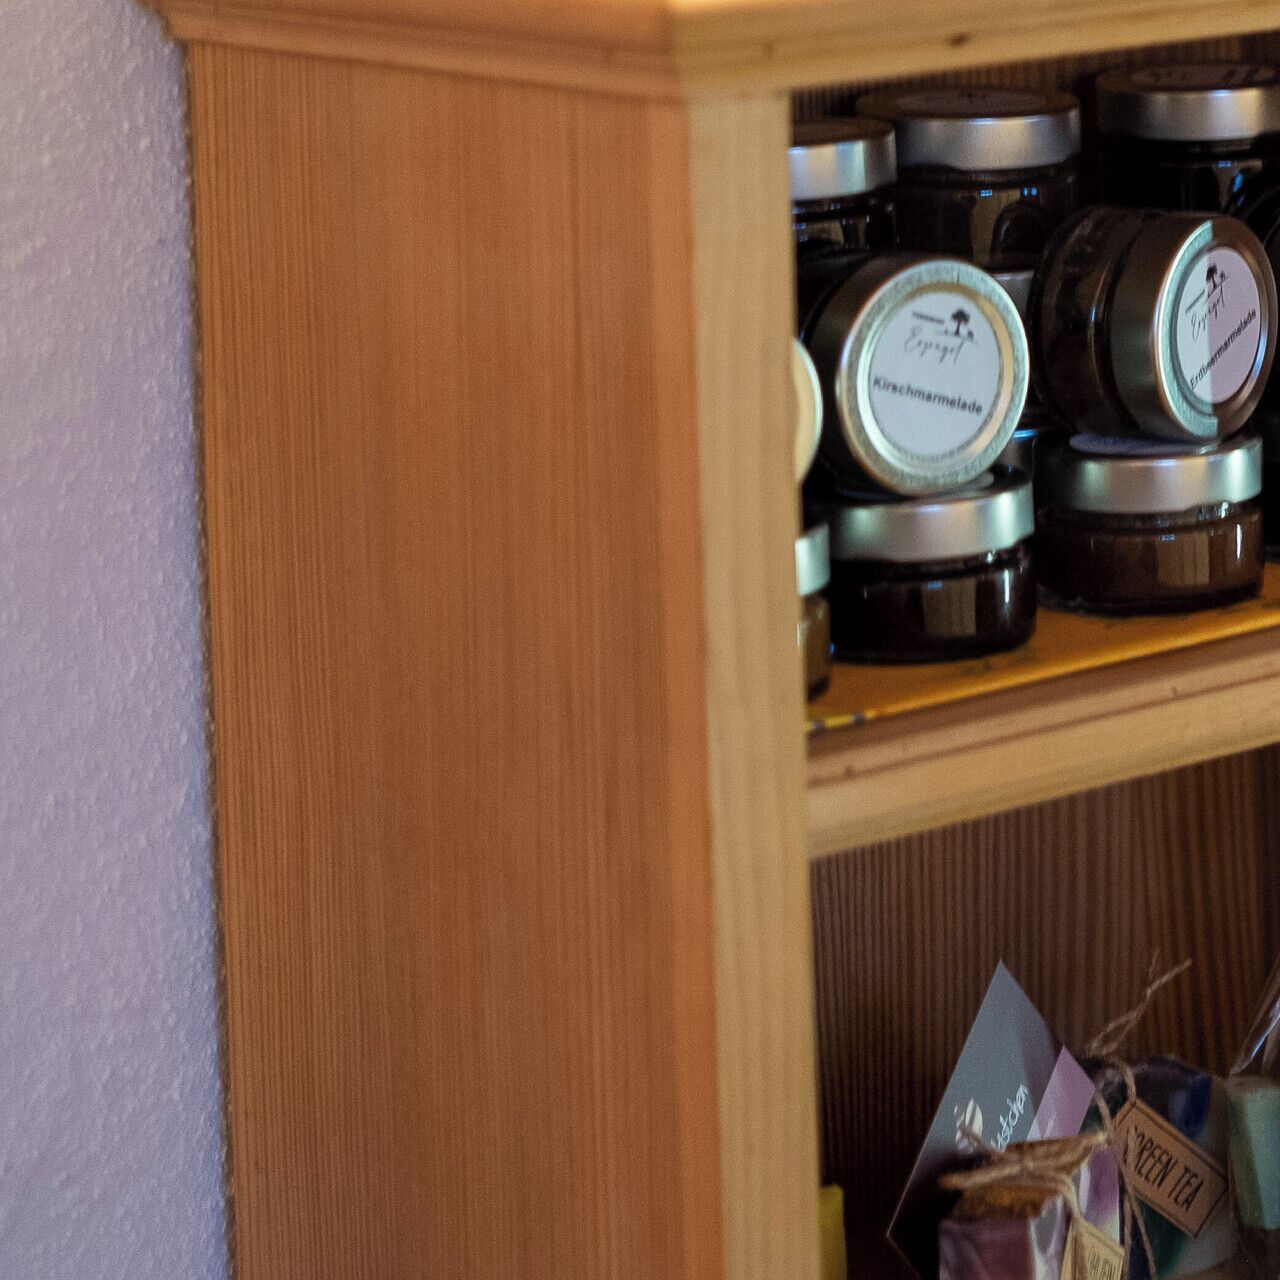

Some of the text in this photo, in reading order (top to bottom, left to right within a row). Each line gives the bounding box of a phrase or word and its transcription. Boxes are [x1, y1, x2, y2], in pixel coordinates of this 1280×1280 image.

[1189, 308, 1257, 391] Erdbeermarmelade
[872, 375, 983, 416] Kirschmarmelade
[1167, 1164, 1205, 1213] TEA
